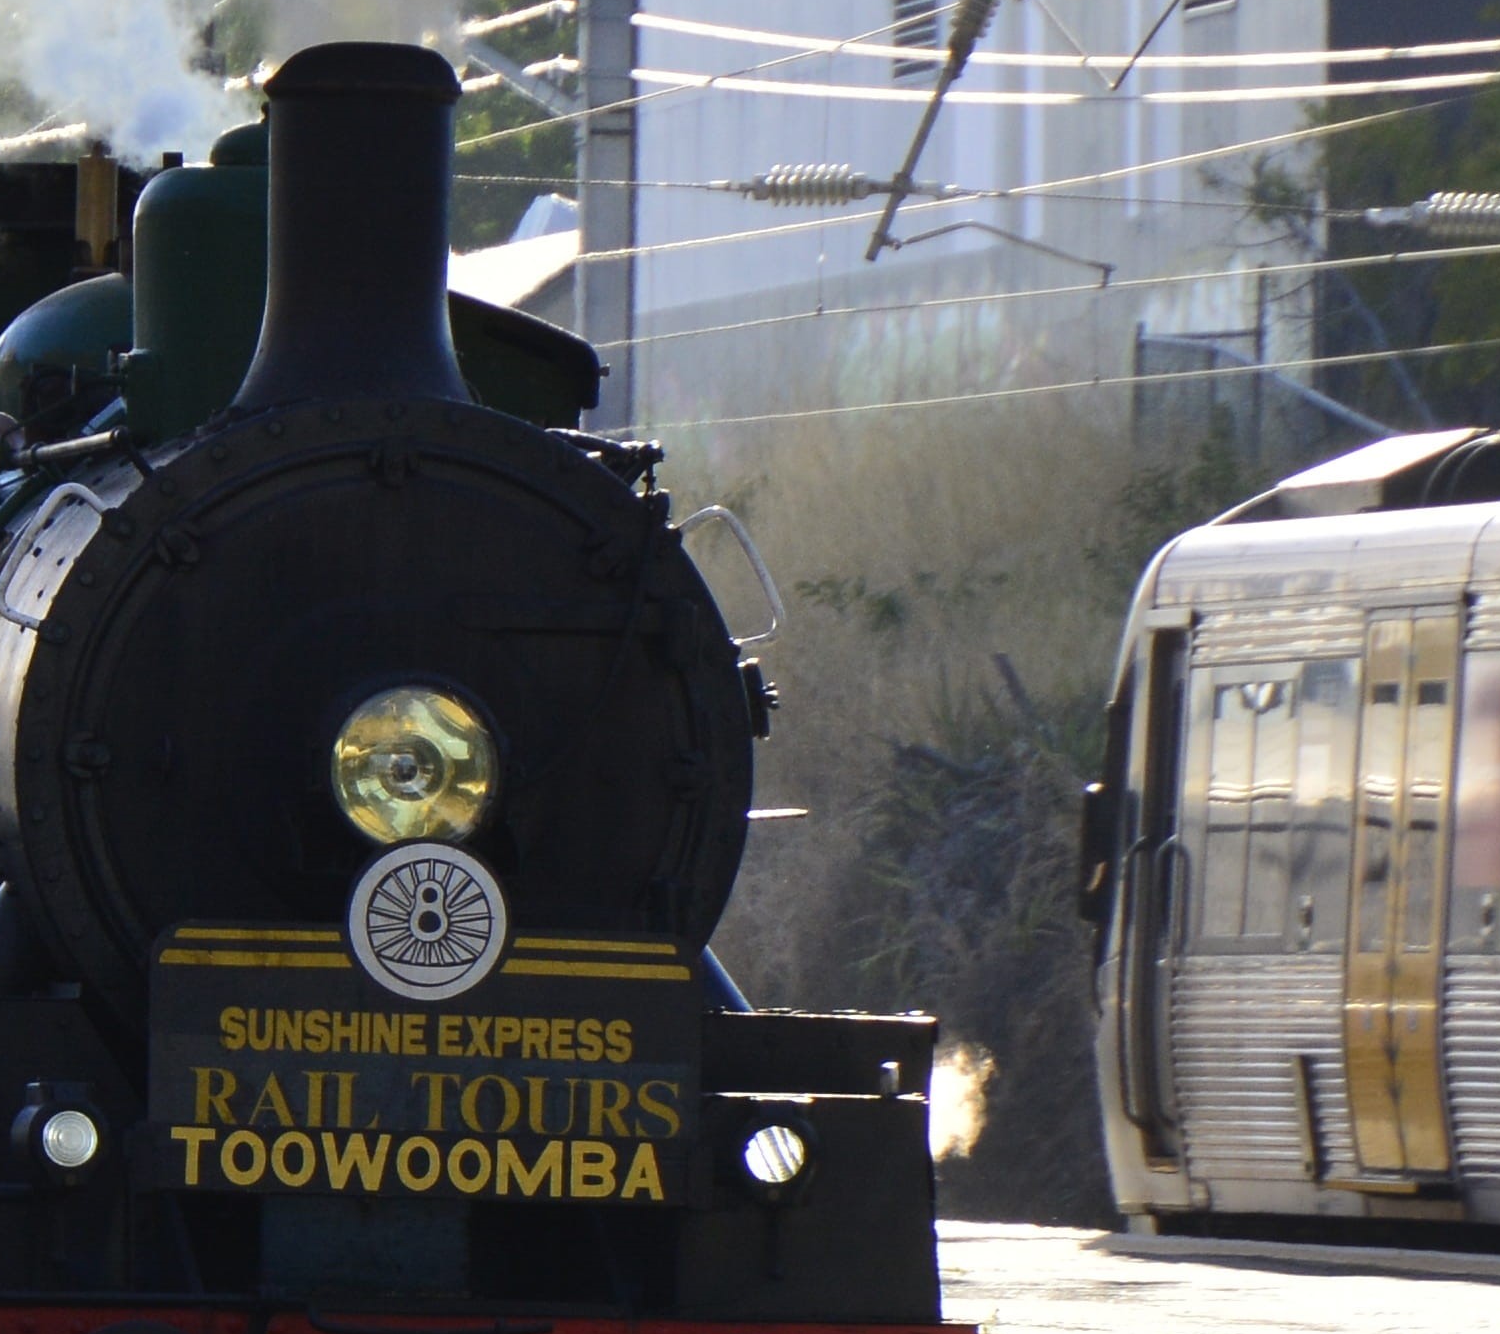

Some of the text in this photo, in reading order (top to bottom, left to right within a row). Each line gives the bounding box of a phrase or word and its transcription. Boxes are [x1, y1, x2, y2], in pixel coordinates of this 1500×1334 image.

[219, 1006, 633, 1063] SUNSHINE EXPRESS
[189, 1066, 681, 1139] RAIL TOURS
[170, 1126, 664, 1201] TOOWOOMBA
